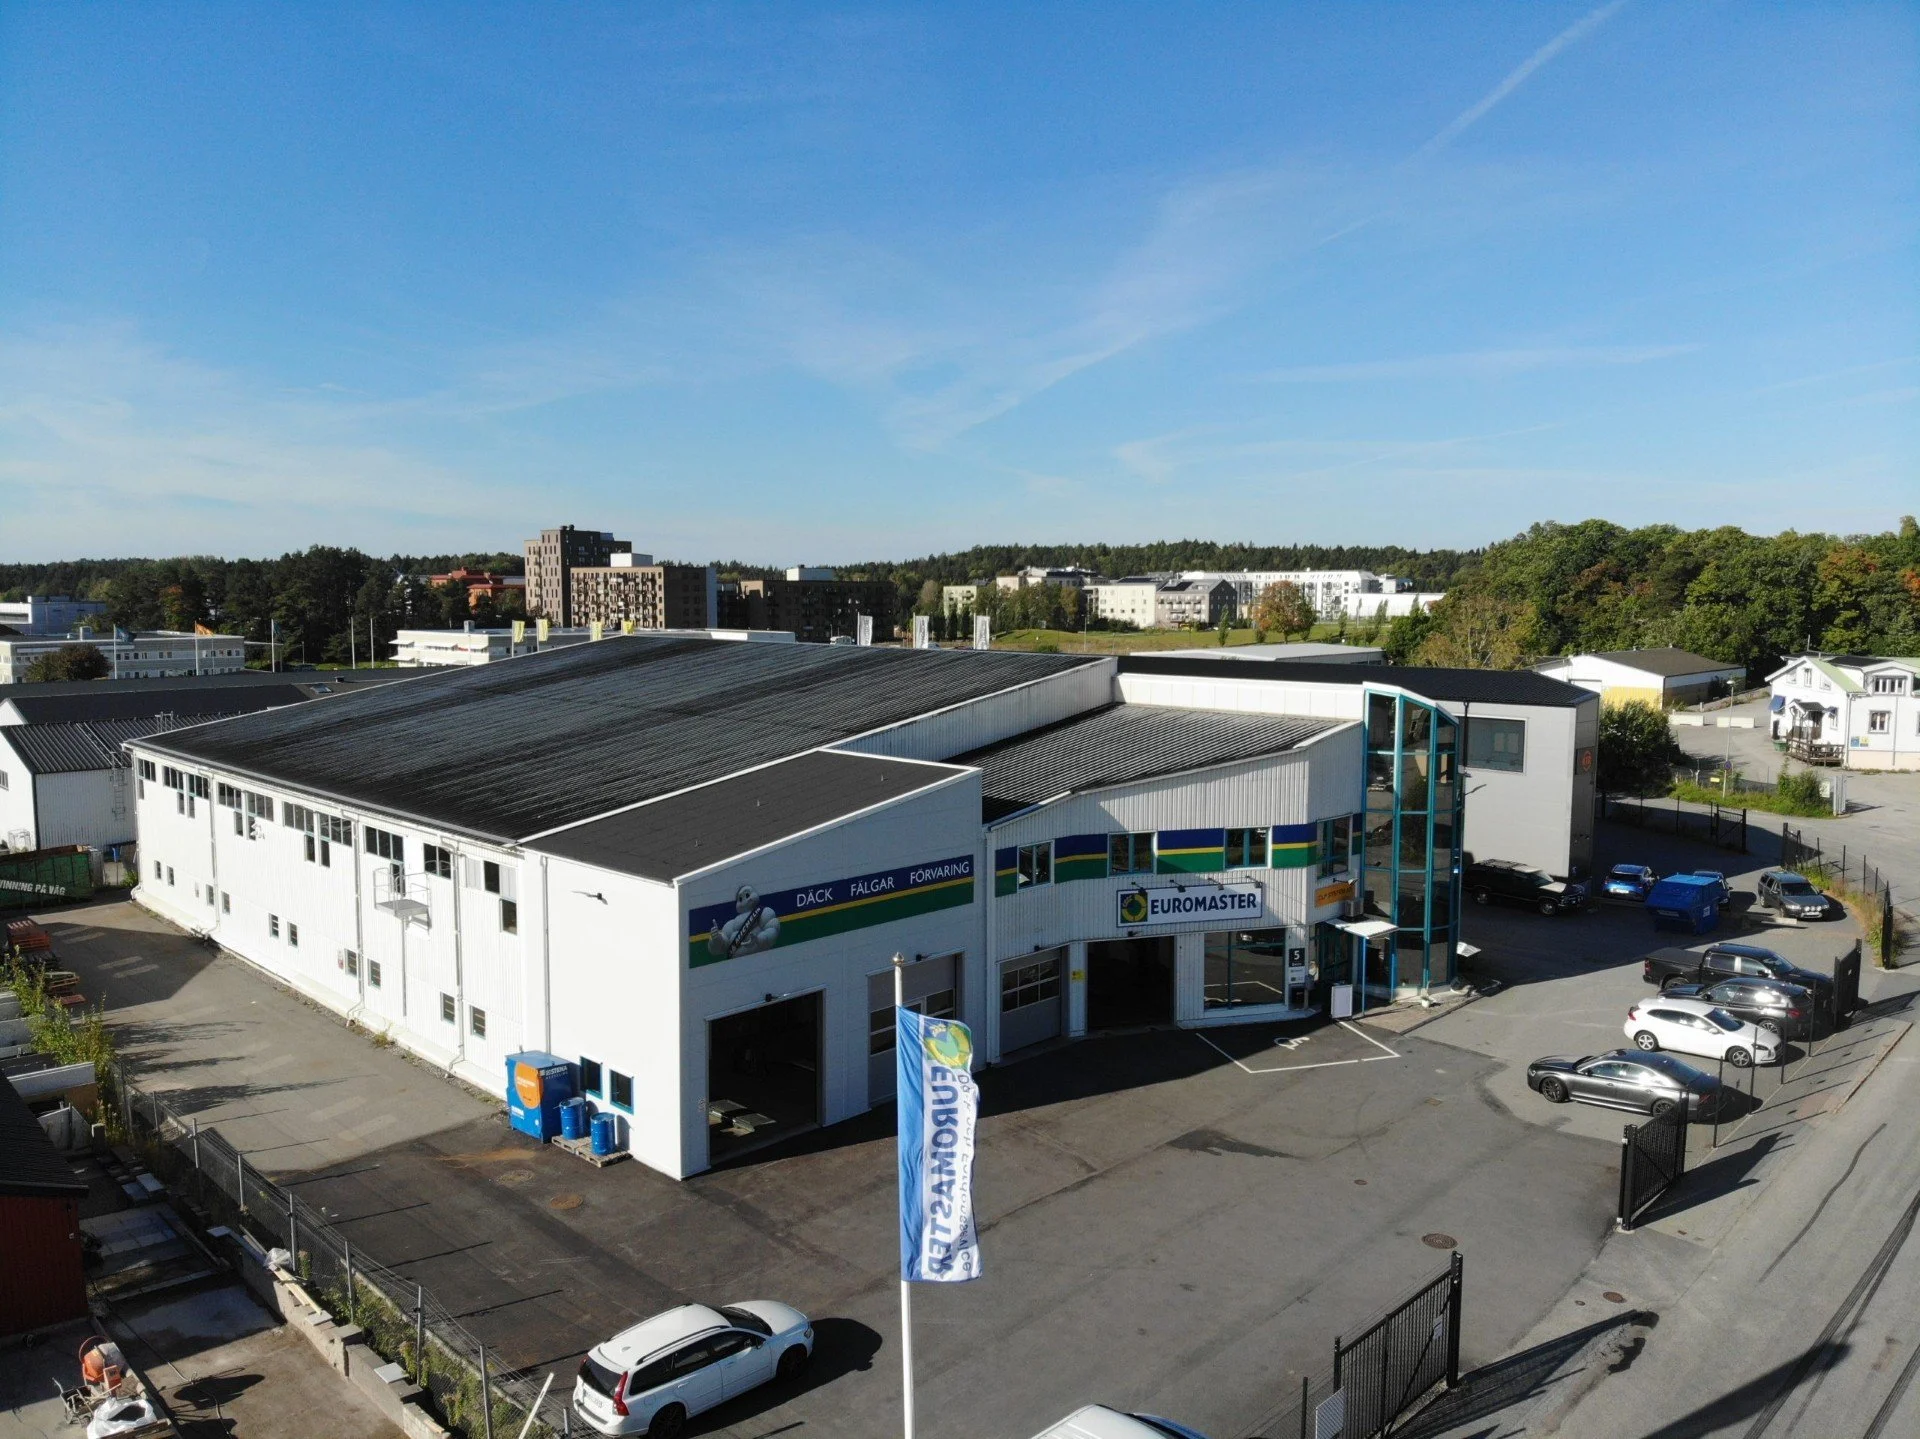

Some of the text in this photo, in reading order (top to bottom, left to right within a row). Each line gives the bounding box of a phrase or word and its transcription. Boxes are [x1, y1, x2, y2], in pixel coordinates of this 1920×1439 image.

[796, 861, 970, 908] DÄCK FÄLGAR FÖRVARING
[1150, 893, 1257, 915] EUROMASTER
[1294, 950, 1300, 960] 5
